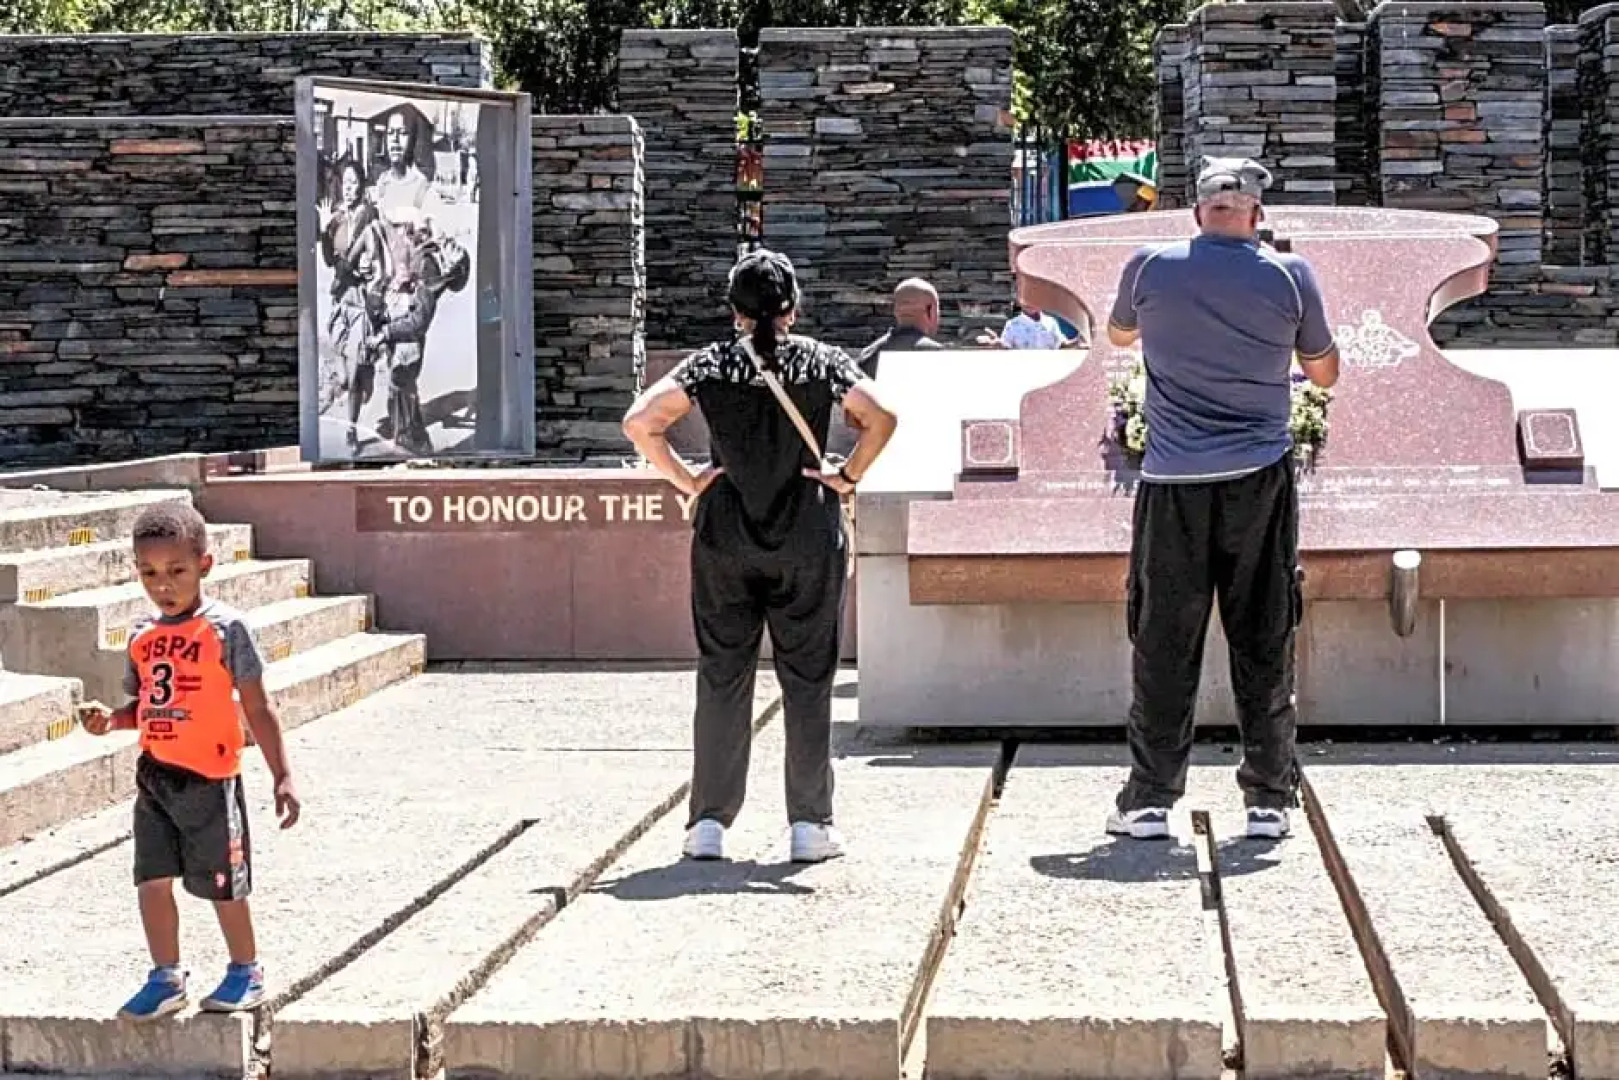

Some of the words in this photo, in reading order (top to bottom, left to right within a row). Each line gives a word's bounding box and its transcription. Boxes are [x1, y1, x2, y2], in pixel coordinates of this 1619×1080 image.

[386, 495, 433, 523] TO
[443, 495, 588, 523] HONOUR
[598, 494, 664, 521] THE
[149, 663, 173, 706] 3
